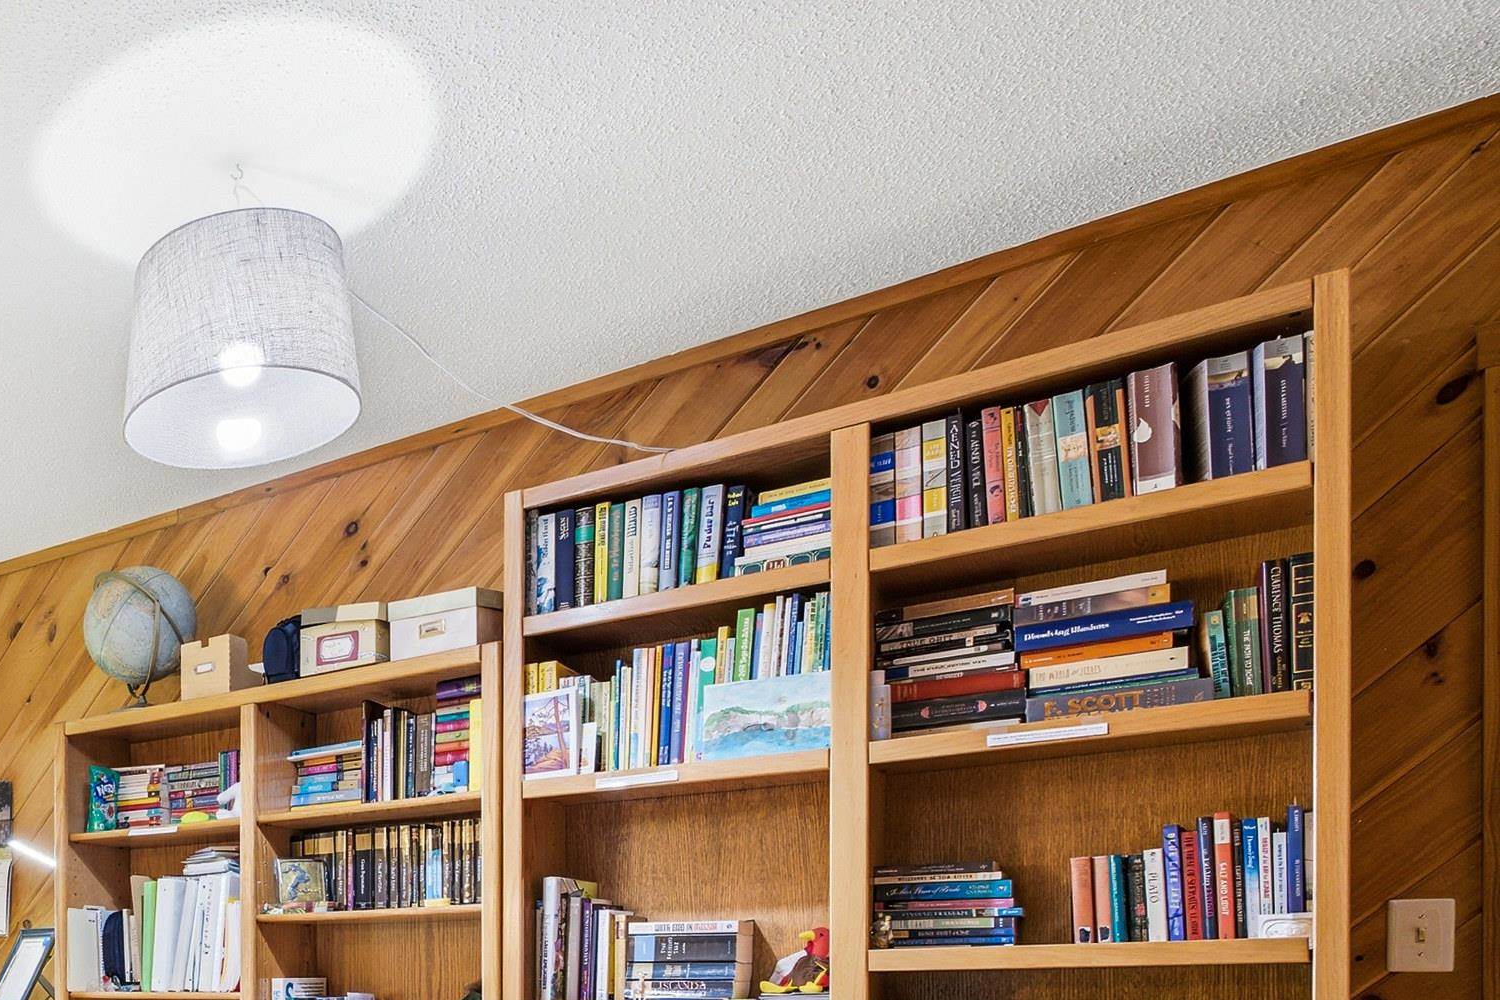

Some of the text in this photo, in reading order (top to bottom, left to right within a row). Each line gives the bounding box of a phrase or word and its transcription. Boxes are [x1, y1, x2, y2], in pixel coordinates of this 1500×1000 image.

[703, 536, 712, 550] Pu
[1270, 566, 1283, 653] CLARENCE THOMAS
[1068, 690, 1142, 713] SCOTT
[1148, 872, 1159, 903] PLATO
